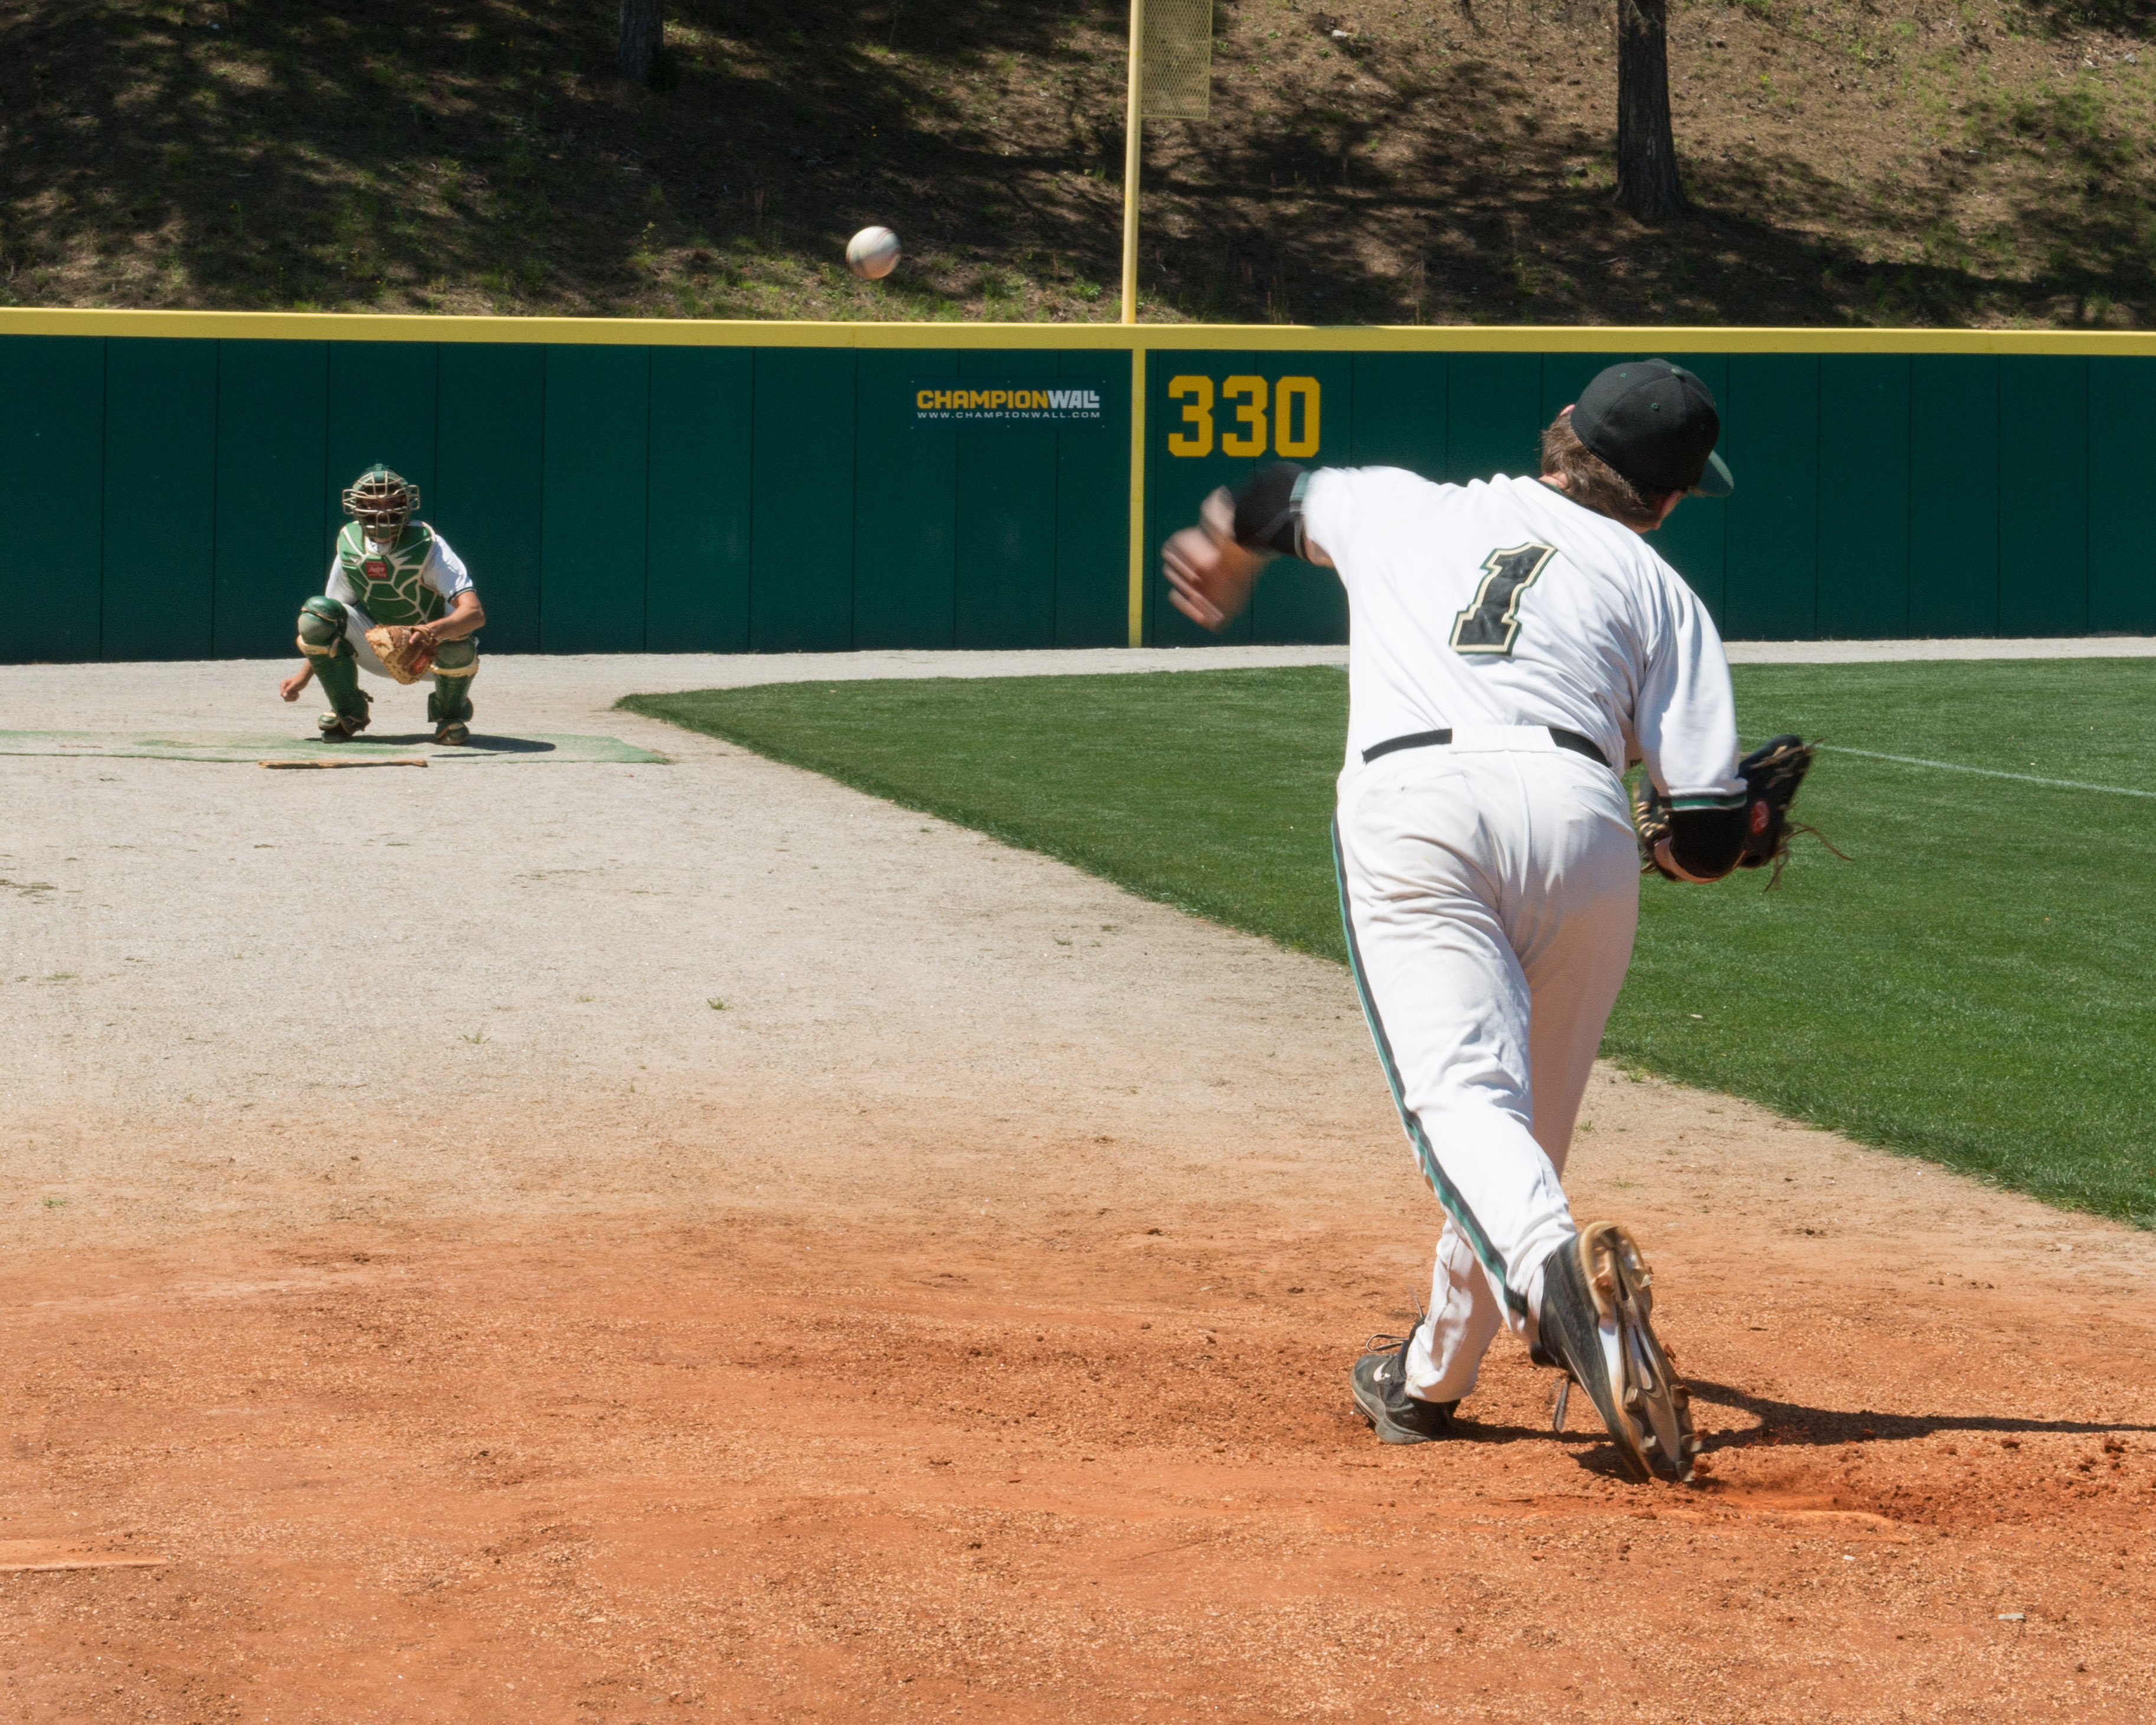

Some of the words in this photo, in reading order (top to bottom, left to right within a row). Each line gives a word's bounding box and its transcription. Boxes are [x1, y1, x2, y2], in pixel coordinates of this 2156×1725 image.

[917, 390, 1100, 409] CHAMPIONWALL
[1168, 375, 1321, 458] 330
[1448, 542, 1558, 656] 1
